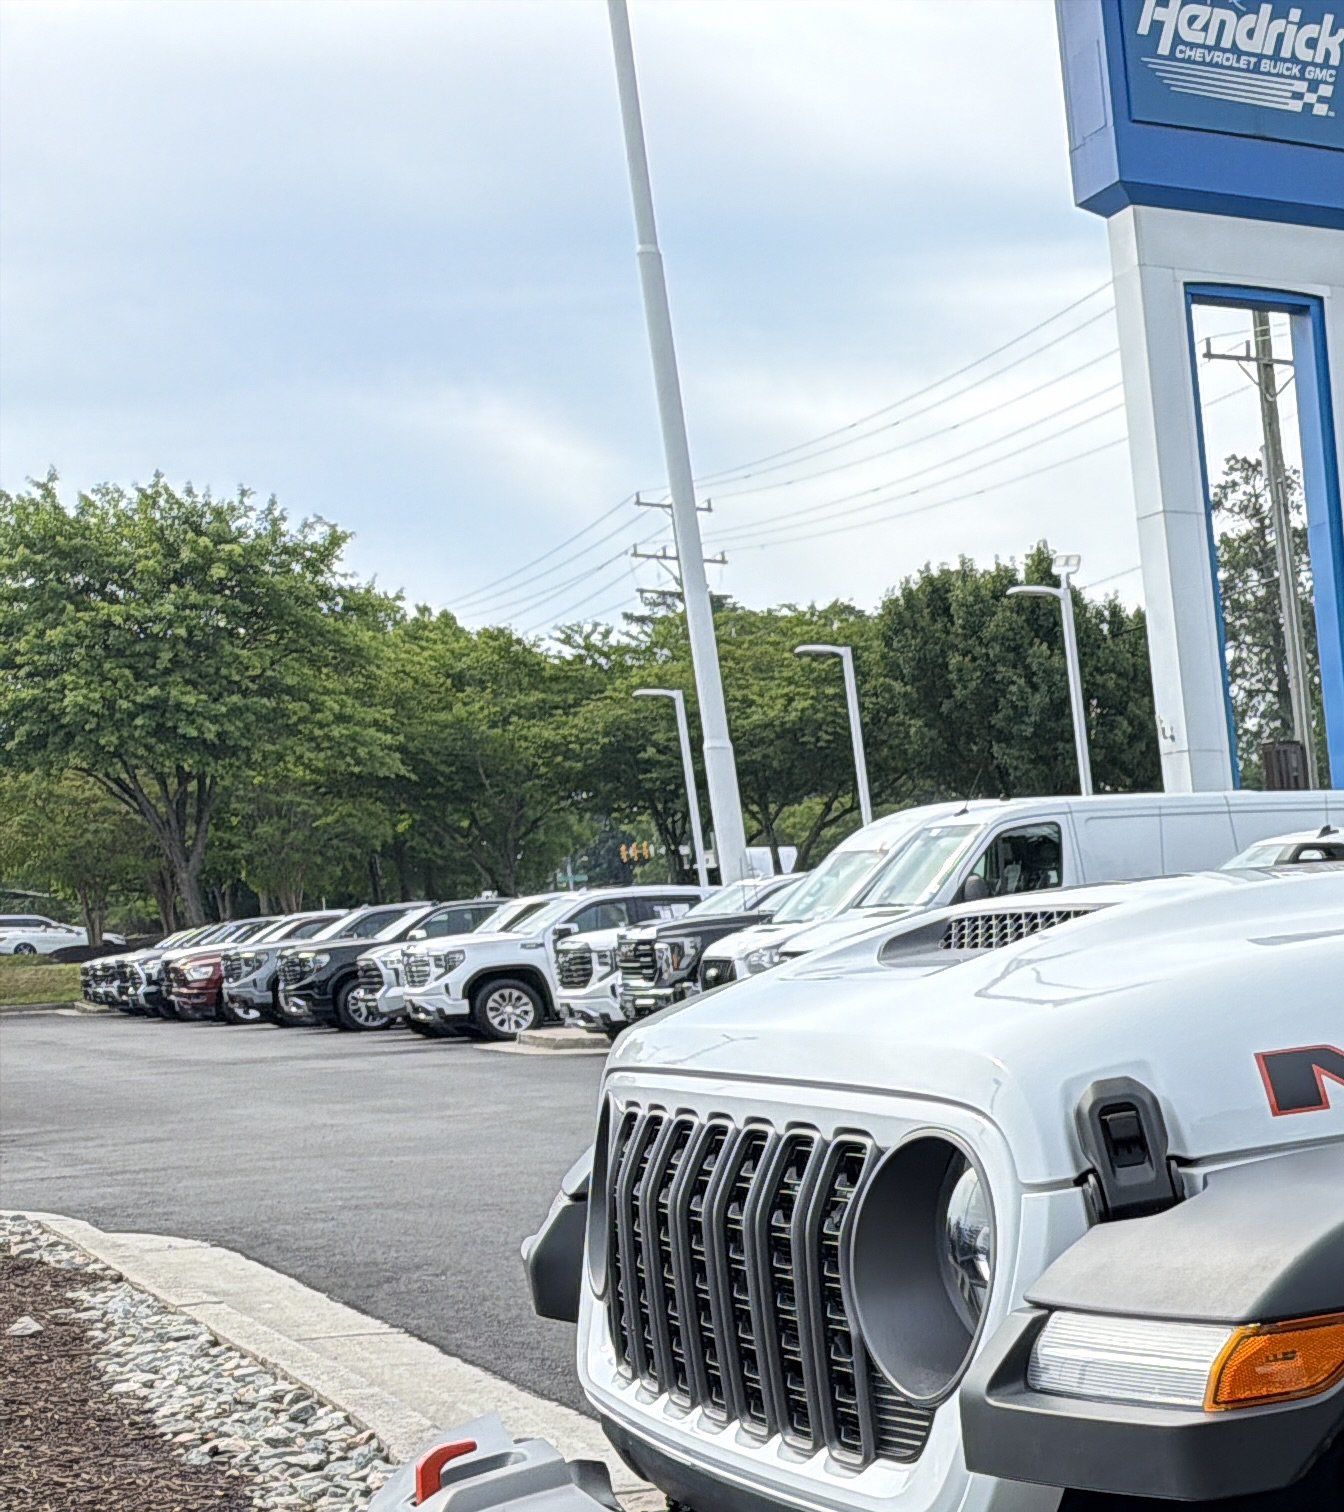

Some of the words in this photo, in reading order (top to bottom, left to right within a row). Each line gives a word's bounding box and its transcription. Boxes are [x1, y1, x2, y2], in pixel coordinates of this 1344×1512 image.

[1175, 45, 1257, 71] CHEVROLET
[1260, 59, 1302, 77] BUICK
[1304, 66, 1337, 83] GMC
